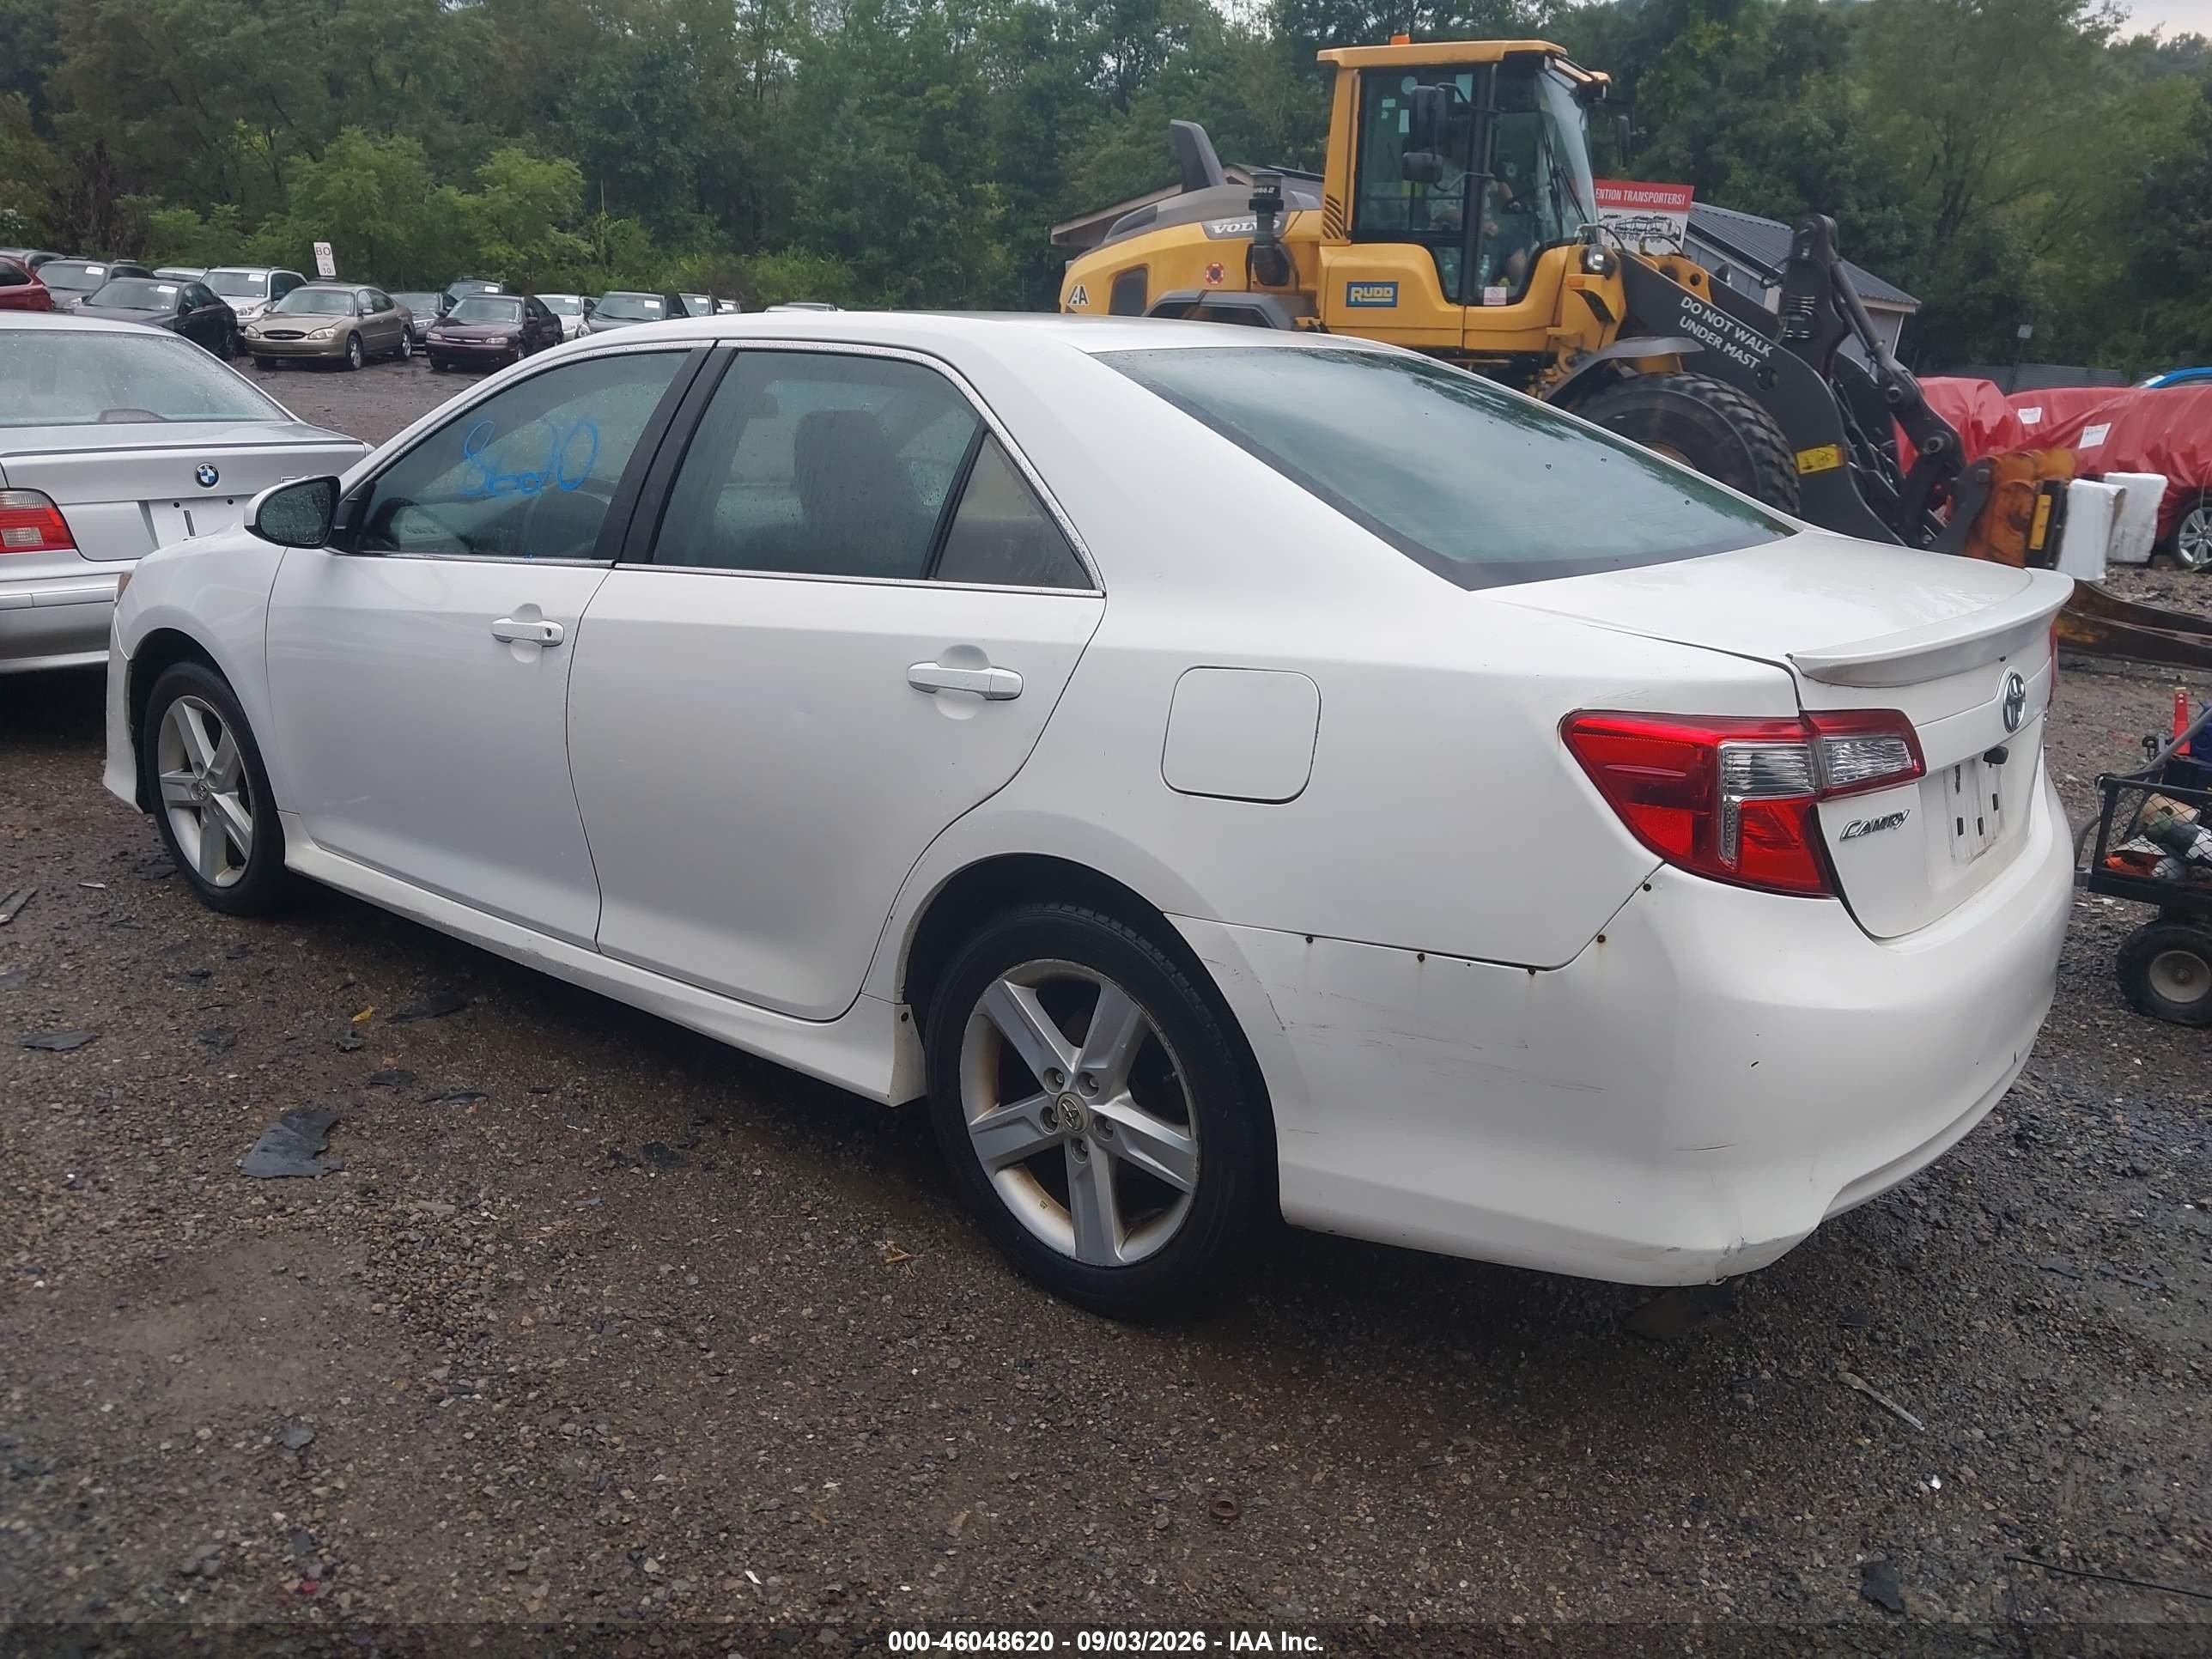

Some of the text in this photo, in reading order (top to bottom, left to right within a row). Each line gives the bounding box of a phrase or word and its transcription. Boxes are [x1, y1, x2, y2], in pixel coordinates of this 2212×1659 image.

[1624, 190, 1686, 205] TRANSPORTERS!
[1351, 287, 1394, 302] RUDD
[1679, 315, 1761, 369] UNDER MAST
[1680, 295, 1774, 358] DO NOT WALK
[1839, 809, 1911, 842] CAMRY
